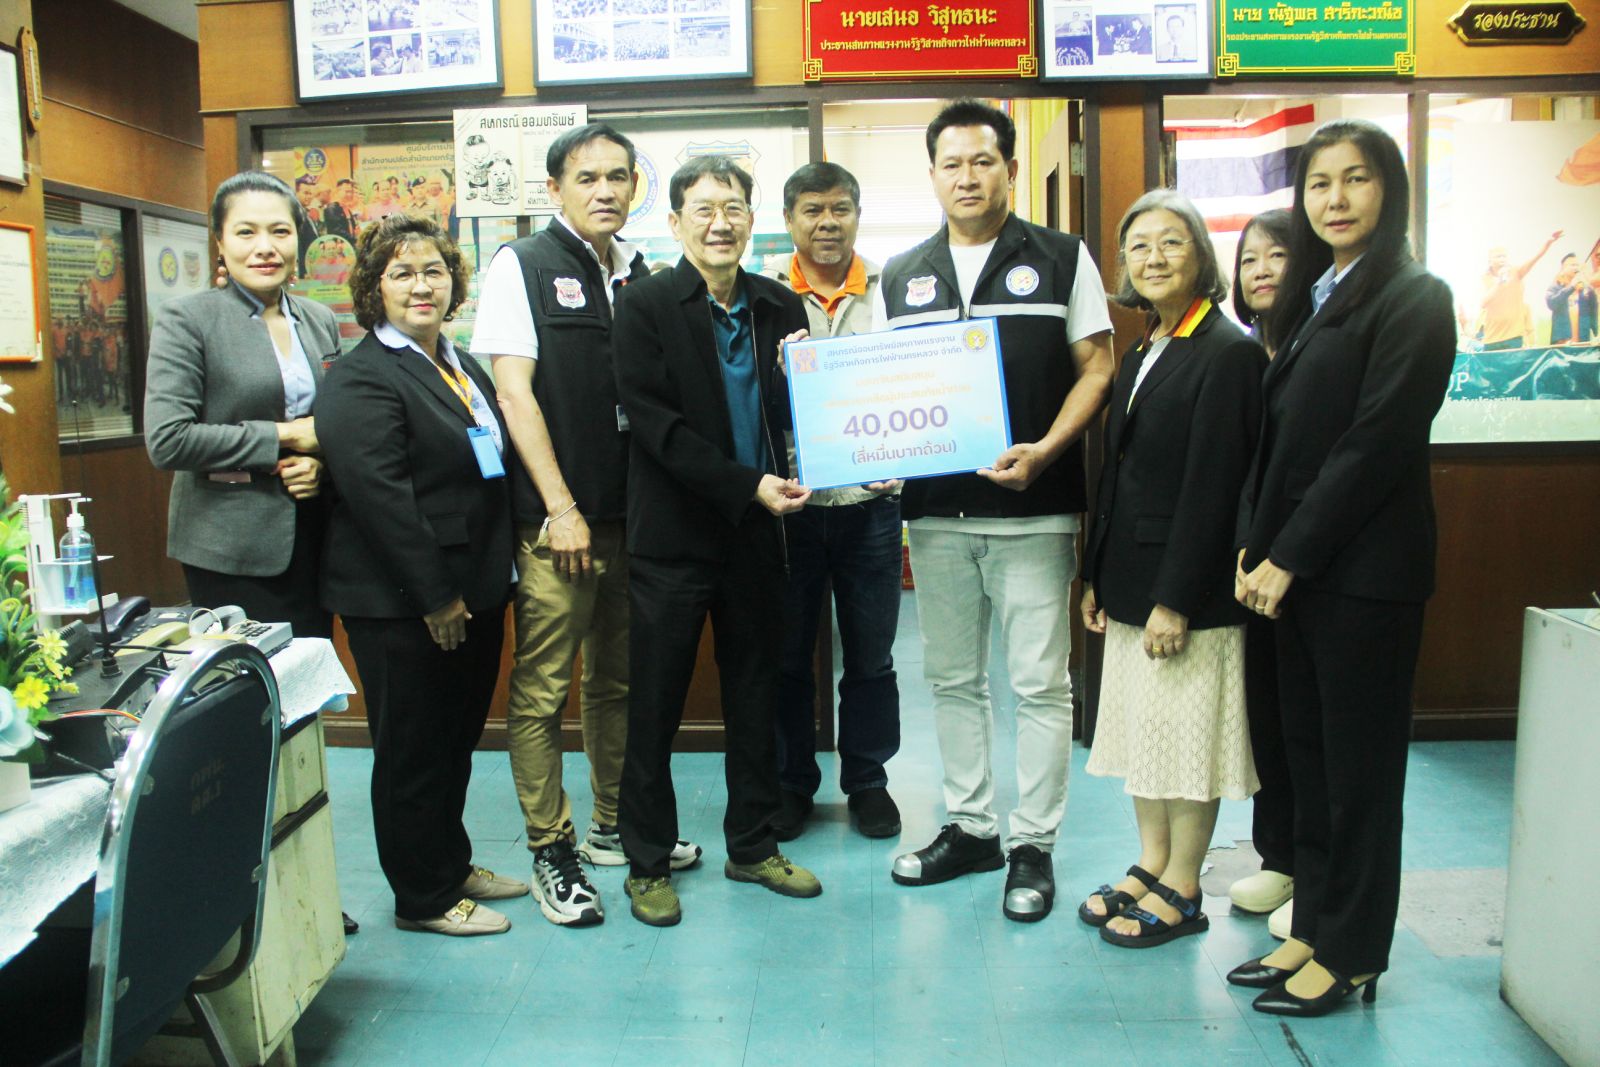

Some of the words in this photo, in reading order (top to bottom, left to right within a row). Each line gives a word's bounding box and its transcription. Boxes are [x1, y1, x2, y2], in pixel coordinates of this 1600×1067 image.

[840, 8, 919, 28] นายเสนอ
[1233, 7, 1262, 21] นาย
[1473, 10, 1562, 31] รองประธาน
[480, 114, 519, 129] สหกรณ์
[521, 112, 575, 127] ออมทรัพย์
[843, 405, 948, 437] 40,000
[852, 440, 957, 465] (สี่หมื่นบาทถ้วน)
